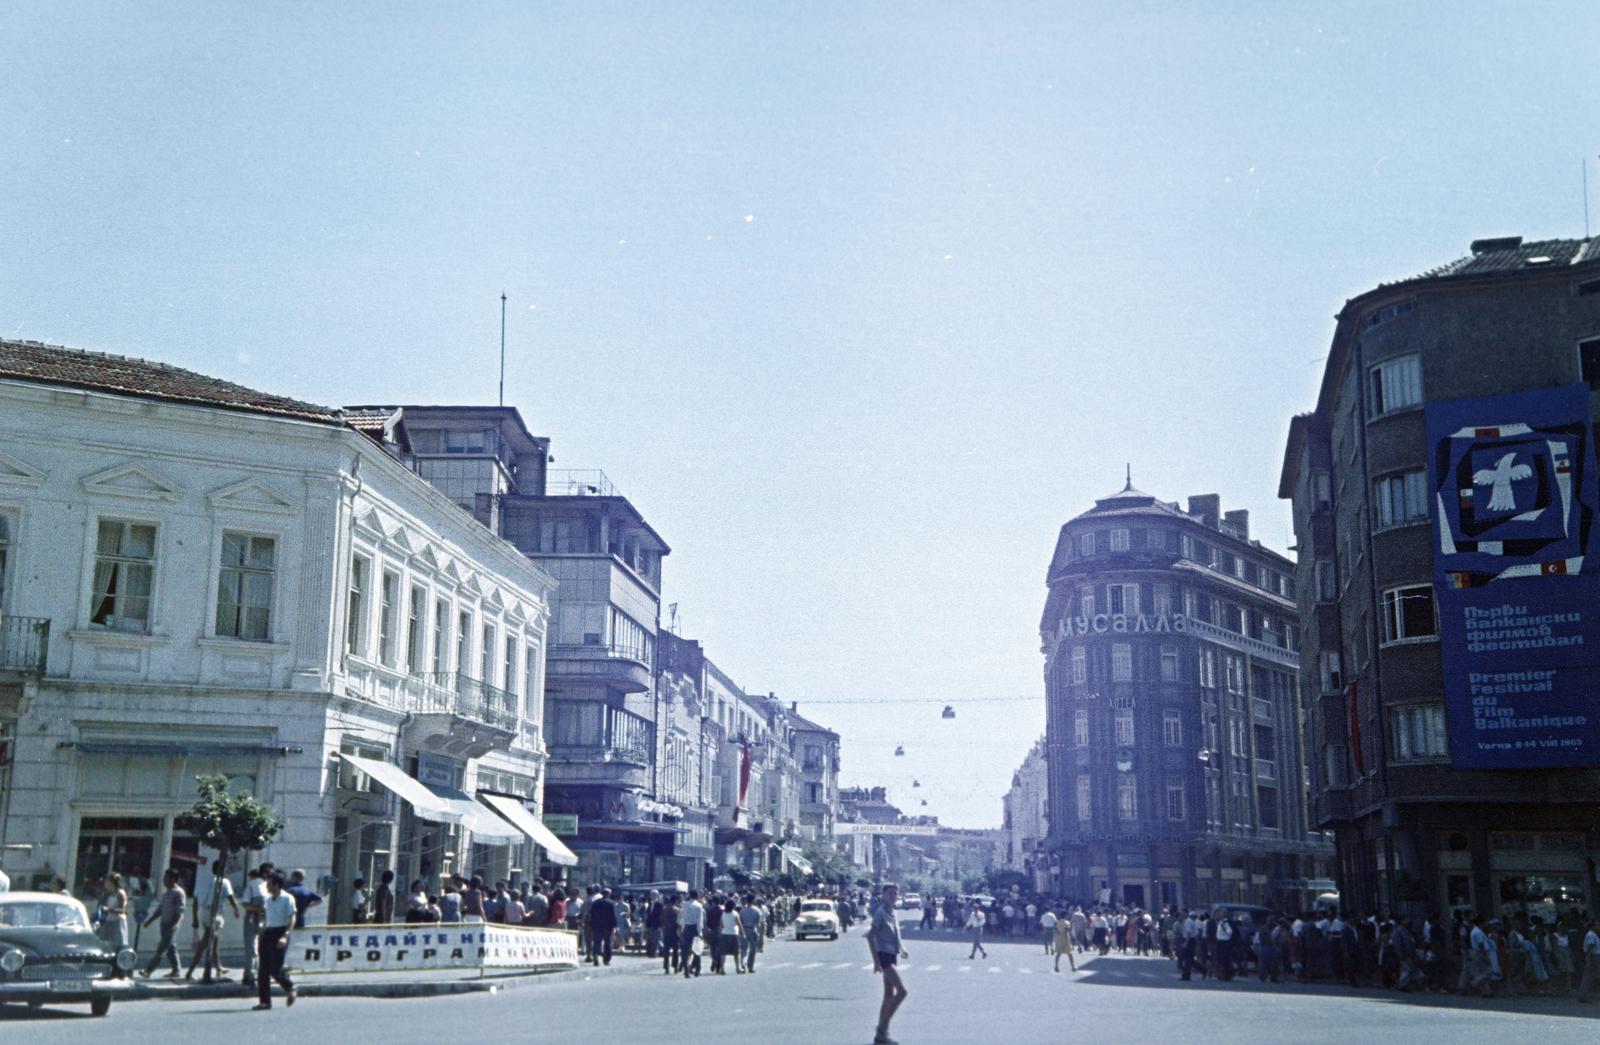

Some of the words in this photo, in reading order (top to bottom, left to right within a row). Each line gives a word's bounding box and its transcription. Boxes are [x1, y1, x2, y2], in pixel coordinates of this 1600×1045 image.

[1464, 604, 1528, 619] Първи
[1466, 624, 1552, 641] филмов
[1467, 635, 1583, 652] фестивал
[1469, 671, 1553, 683] Premier
[1470, 681, 1552, 694] Festival
[1472, 696, 1497, 705] du
[1474, 707, 1514, 717] Film
[1475, 715, 1585, 730] Balkanique
[1478, 742, 1512, 750] Varna
[311, 932, 448, 948] ГЛЕДАЙТЕ
[304, 947, 500, 961] ПРОГРАМА
